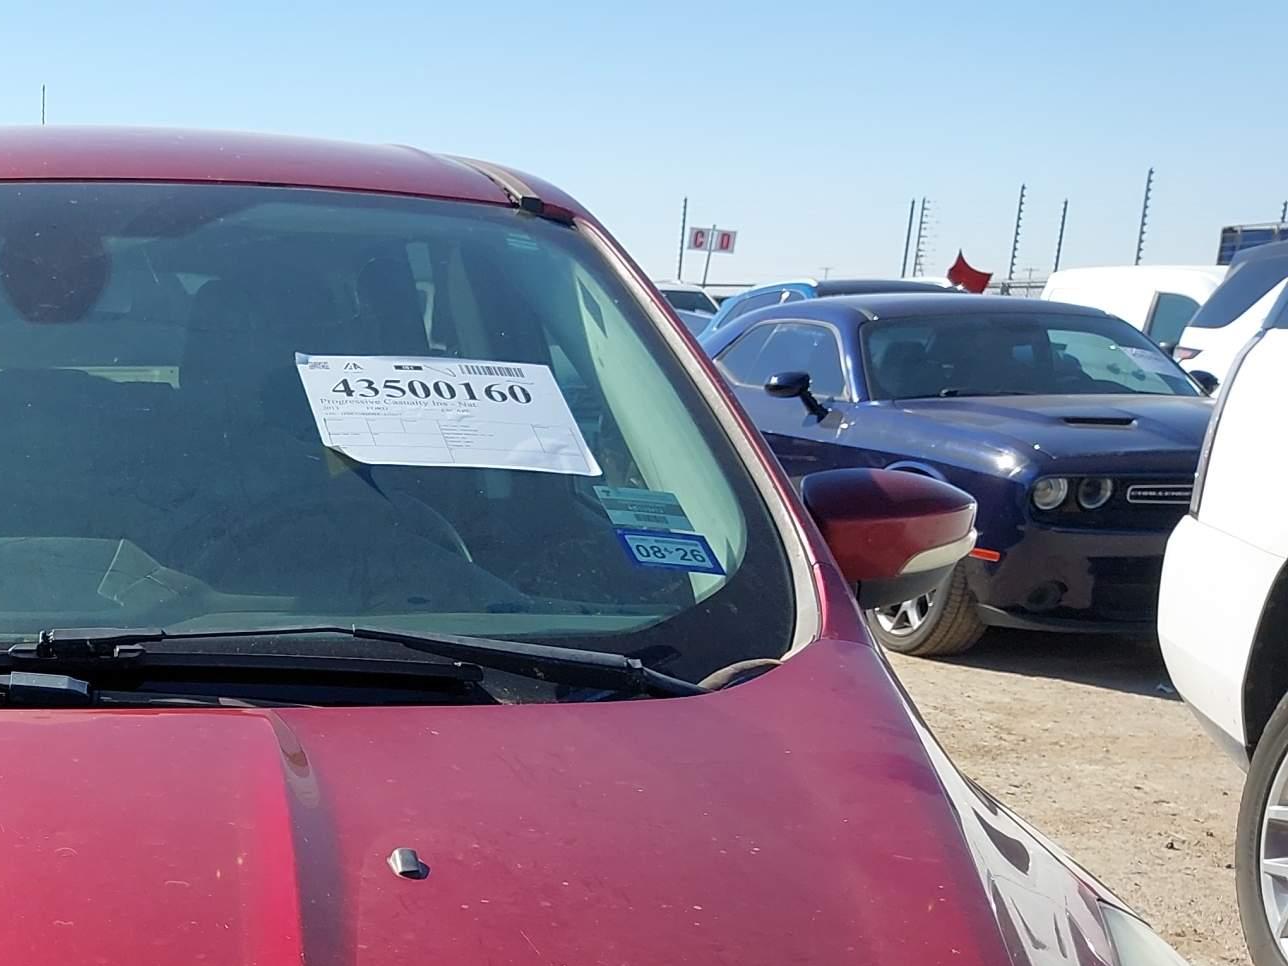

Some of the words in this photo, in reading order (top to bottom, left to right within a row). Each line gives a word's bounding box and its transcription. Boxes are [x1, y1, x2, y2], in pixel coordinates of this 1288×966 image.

[694, 230, 705, 248] C
[332, 378, 533, 405] 43500160
[635, 544, 666, 560] 08
[674, 547, 706, 564] 26
